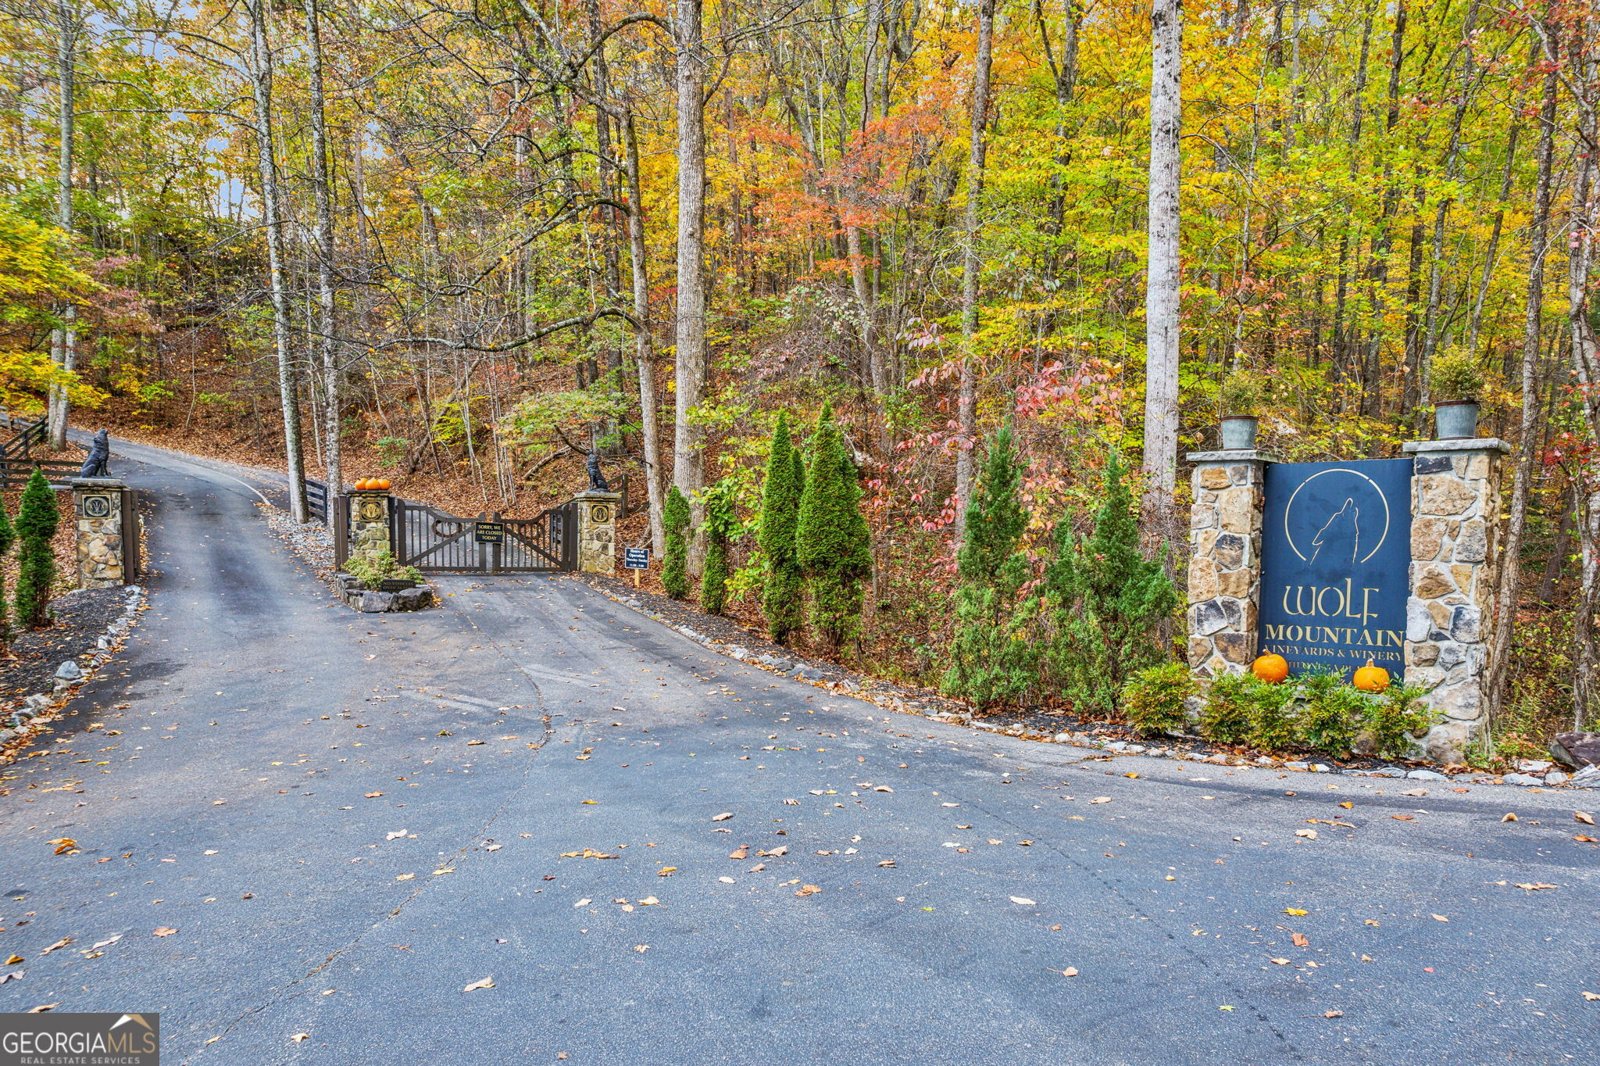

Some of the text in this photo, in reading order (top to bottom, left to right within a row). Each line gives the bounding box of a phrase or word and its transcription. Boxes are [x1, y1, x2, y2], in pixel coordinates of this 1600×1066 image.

[1282, 577, 1380, 627] WOLF
[1265, 624, 1403, 648] MOUNTAIN
[1337, 649, 1346, 658] &
[1350, 649, 1402, 661] WINERY
